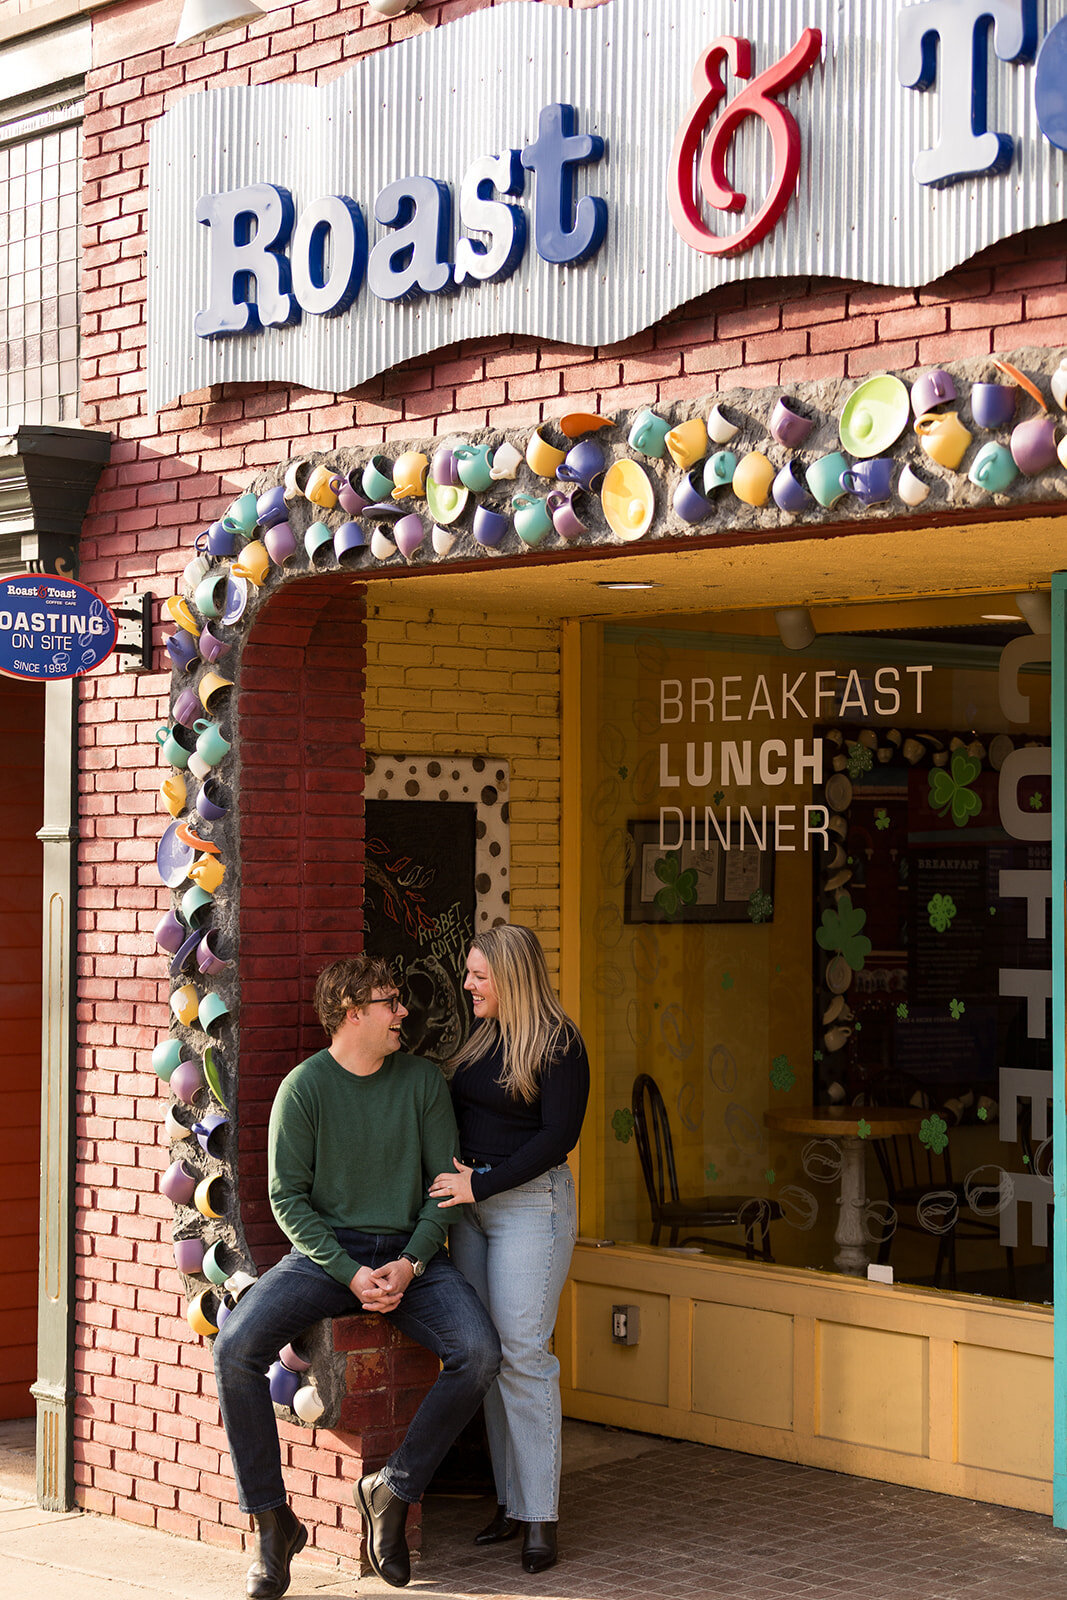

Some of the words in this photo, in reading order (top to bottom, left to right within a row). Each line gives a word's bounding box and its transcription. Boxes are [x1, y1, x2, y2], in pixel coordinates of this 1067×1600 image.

[195, 102, 609, 340] Roast
[667, 26, 823, 258] &
[7, 585, 38, 597] Roast
[37, 585, 48, 598] &
[47, 587, 77, 598] Toast
[12, 633, 34, 649] ON
[41, 634, 73, 651] SITE
[13, 659, 40, 673] SINCE
[43, 662, 68, 673] 1993
[660, 665, 934, 724] BREAKFAST
[659, 737, 823, 787] LUNCH
[659, 804, 831, 851] DINNER
[918, 858, 980, 870] BREAKFAST
[418, 901, 461, 946] RIBBET
[431, 914, 473, 960] COFFEE
